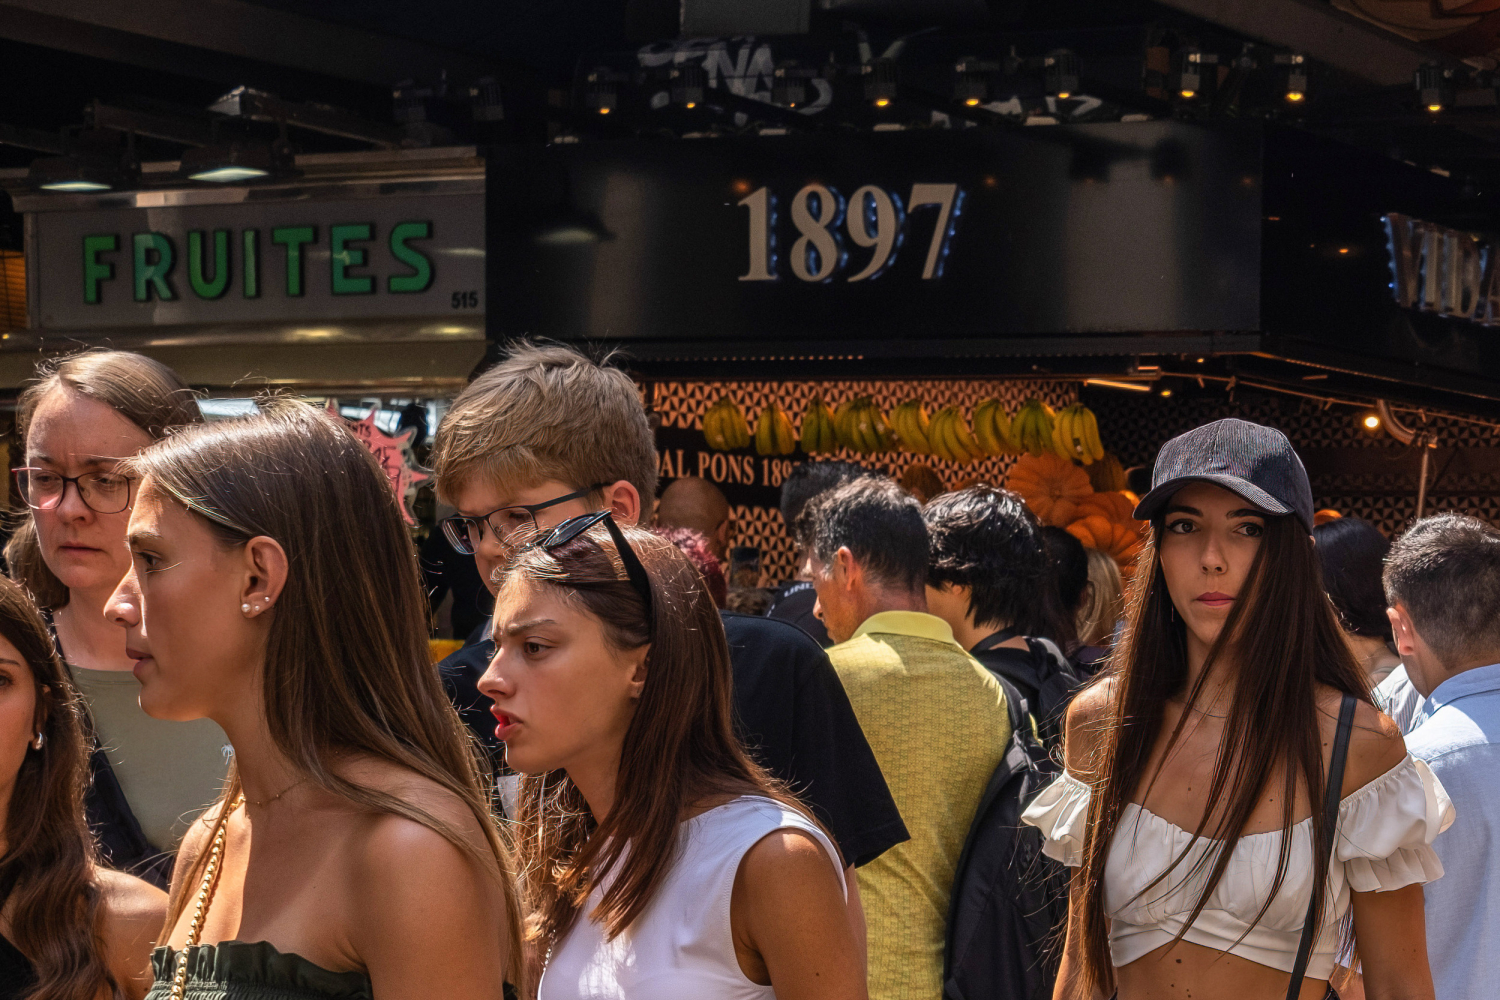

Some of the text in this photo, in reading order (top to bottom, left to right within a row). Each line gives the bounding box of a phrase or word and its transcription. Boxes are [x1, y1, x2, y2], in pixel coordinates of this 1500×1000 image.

[84, 222, 435, 304] FRUITES
[737, 183, 958, 283] 1897
[451, 291, 478, 309] 515
[654, 448, 801, 488] AL PONS 189
